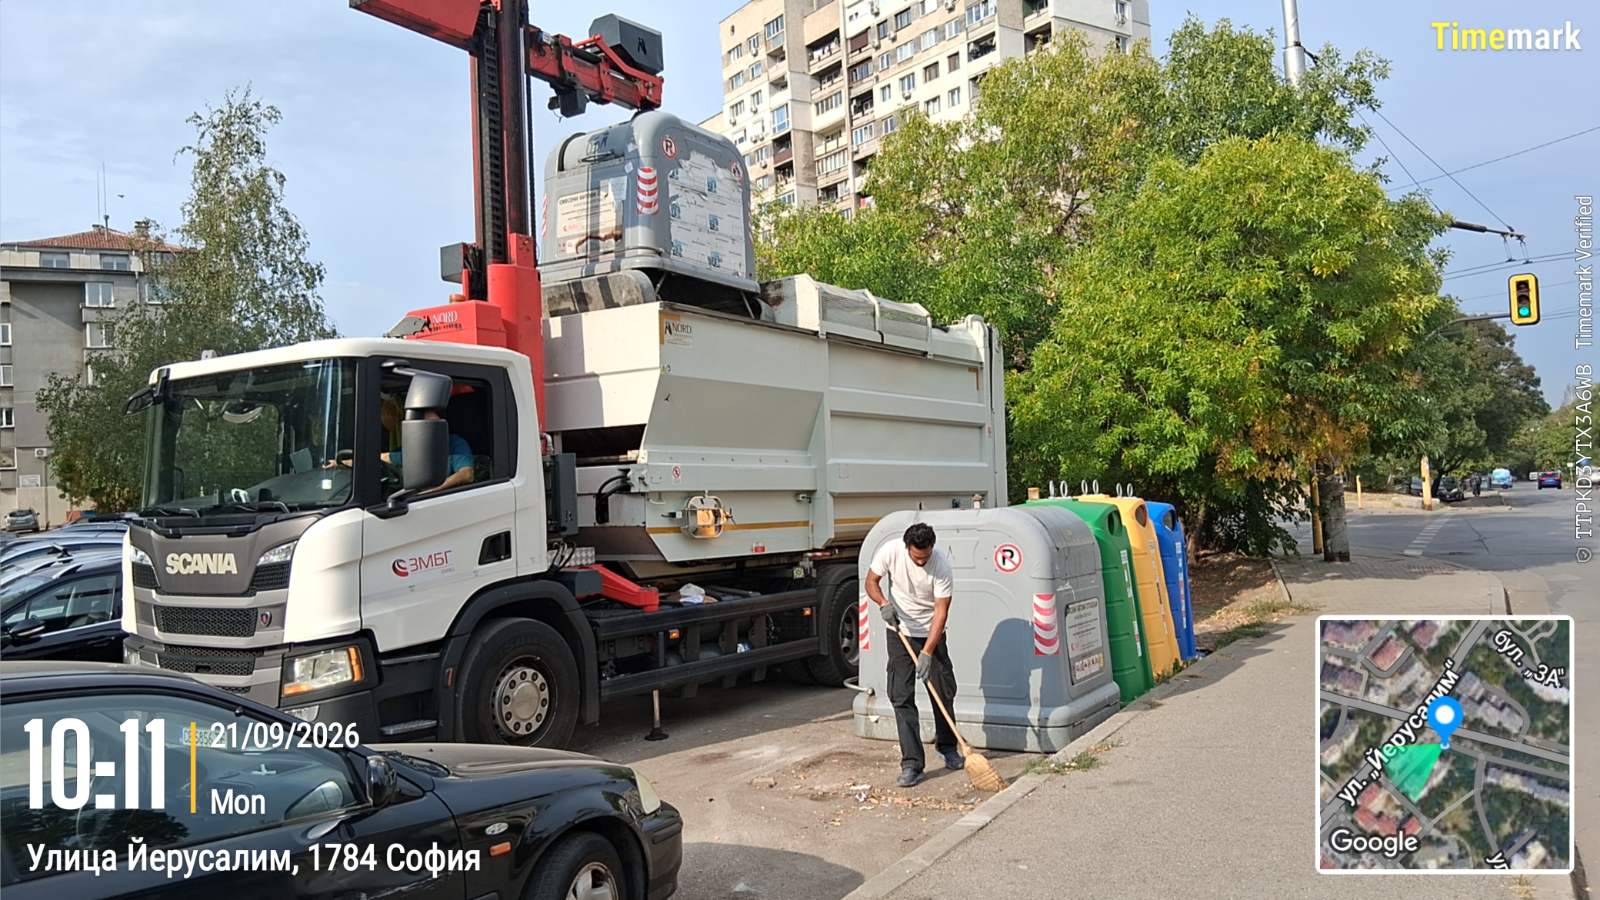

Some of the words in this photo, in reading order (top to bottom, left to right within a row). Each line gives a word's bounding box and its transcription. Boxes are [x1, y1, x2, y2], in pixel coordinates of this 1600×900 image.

[432, 311, 458, 323] NORD
[672, 321, 692, 335] NORD
[165, 552, 238, 575] SCANIA
[408, 550, 452, 572] ЗМБГ
